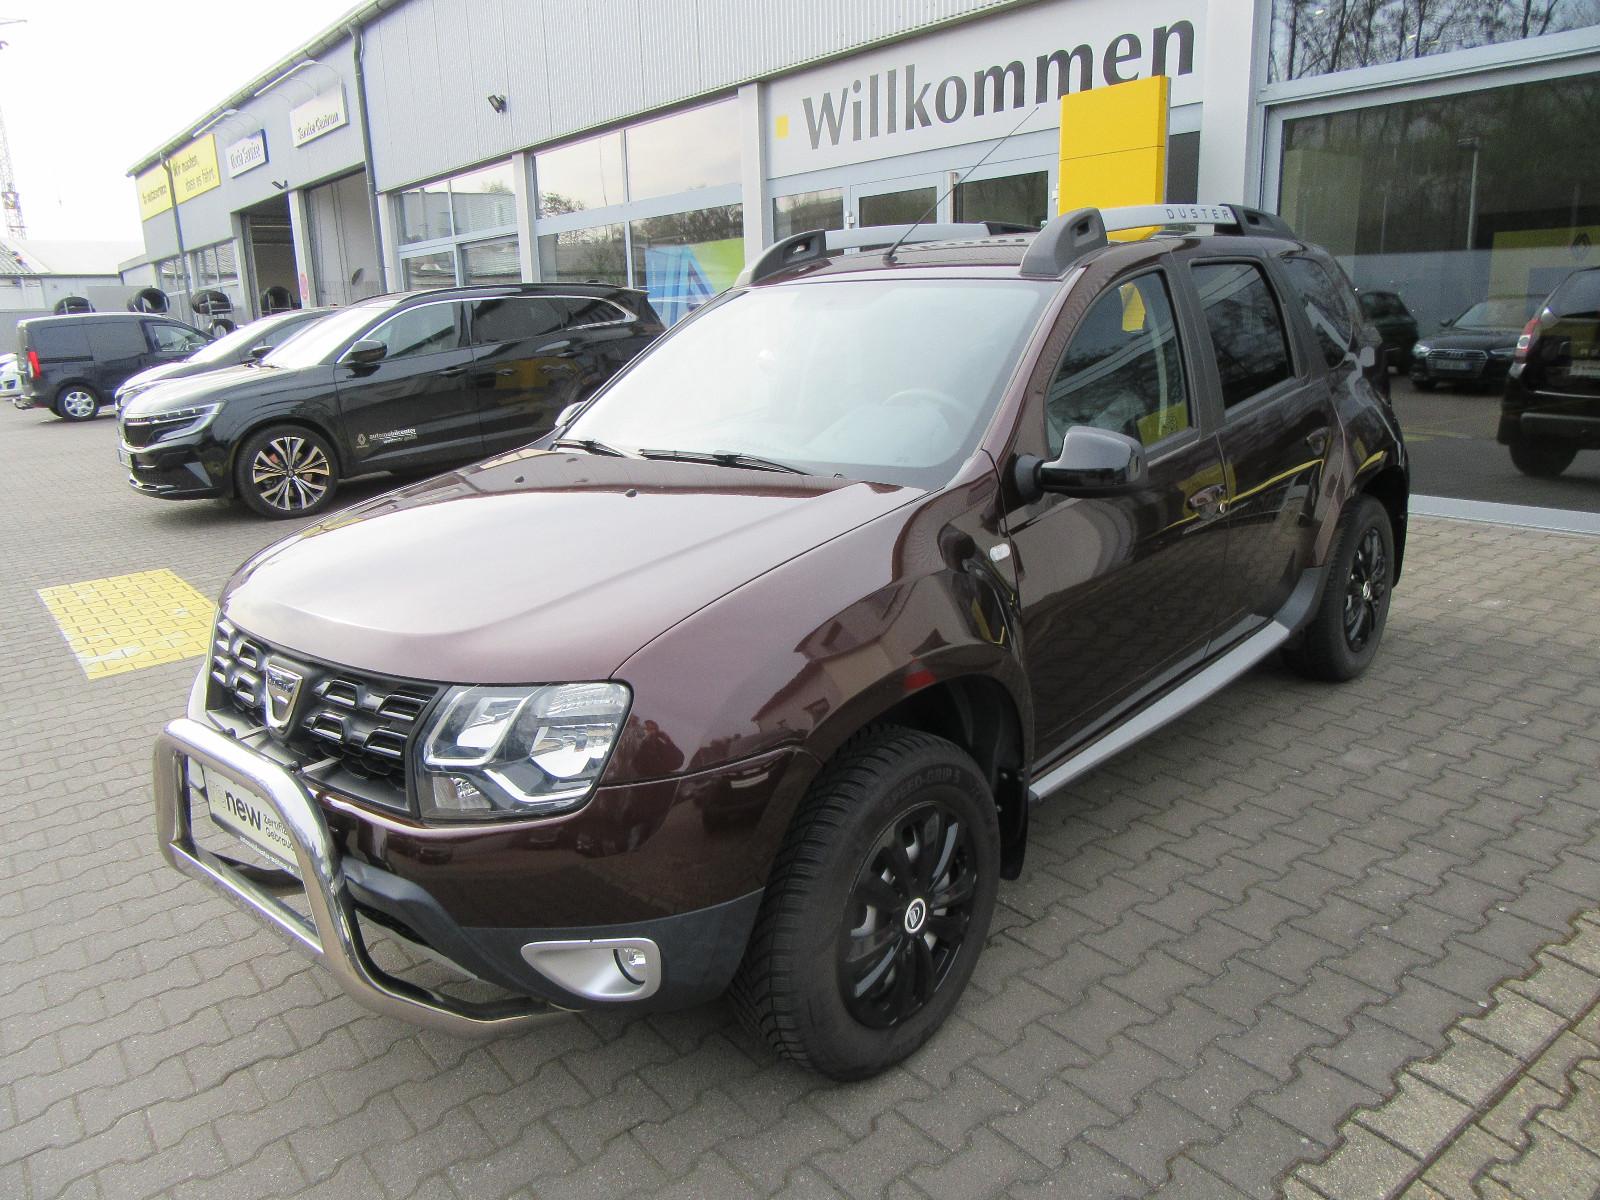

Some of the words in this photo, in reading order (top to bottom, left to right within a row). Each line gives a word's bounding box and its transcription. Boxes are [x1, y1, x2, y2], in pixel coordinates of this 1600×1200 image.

[802, 18, 1195, 151] Willkommen
[1165, 208, 1231, 221] DUSTER
[224, 789, 261, 831] new
